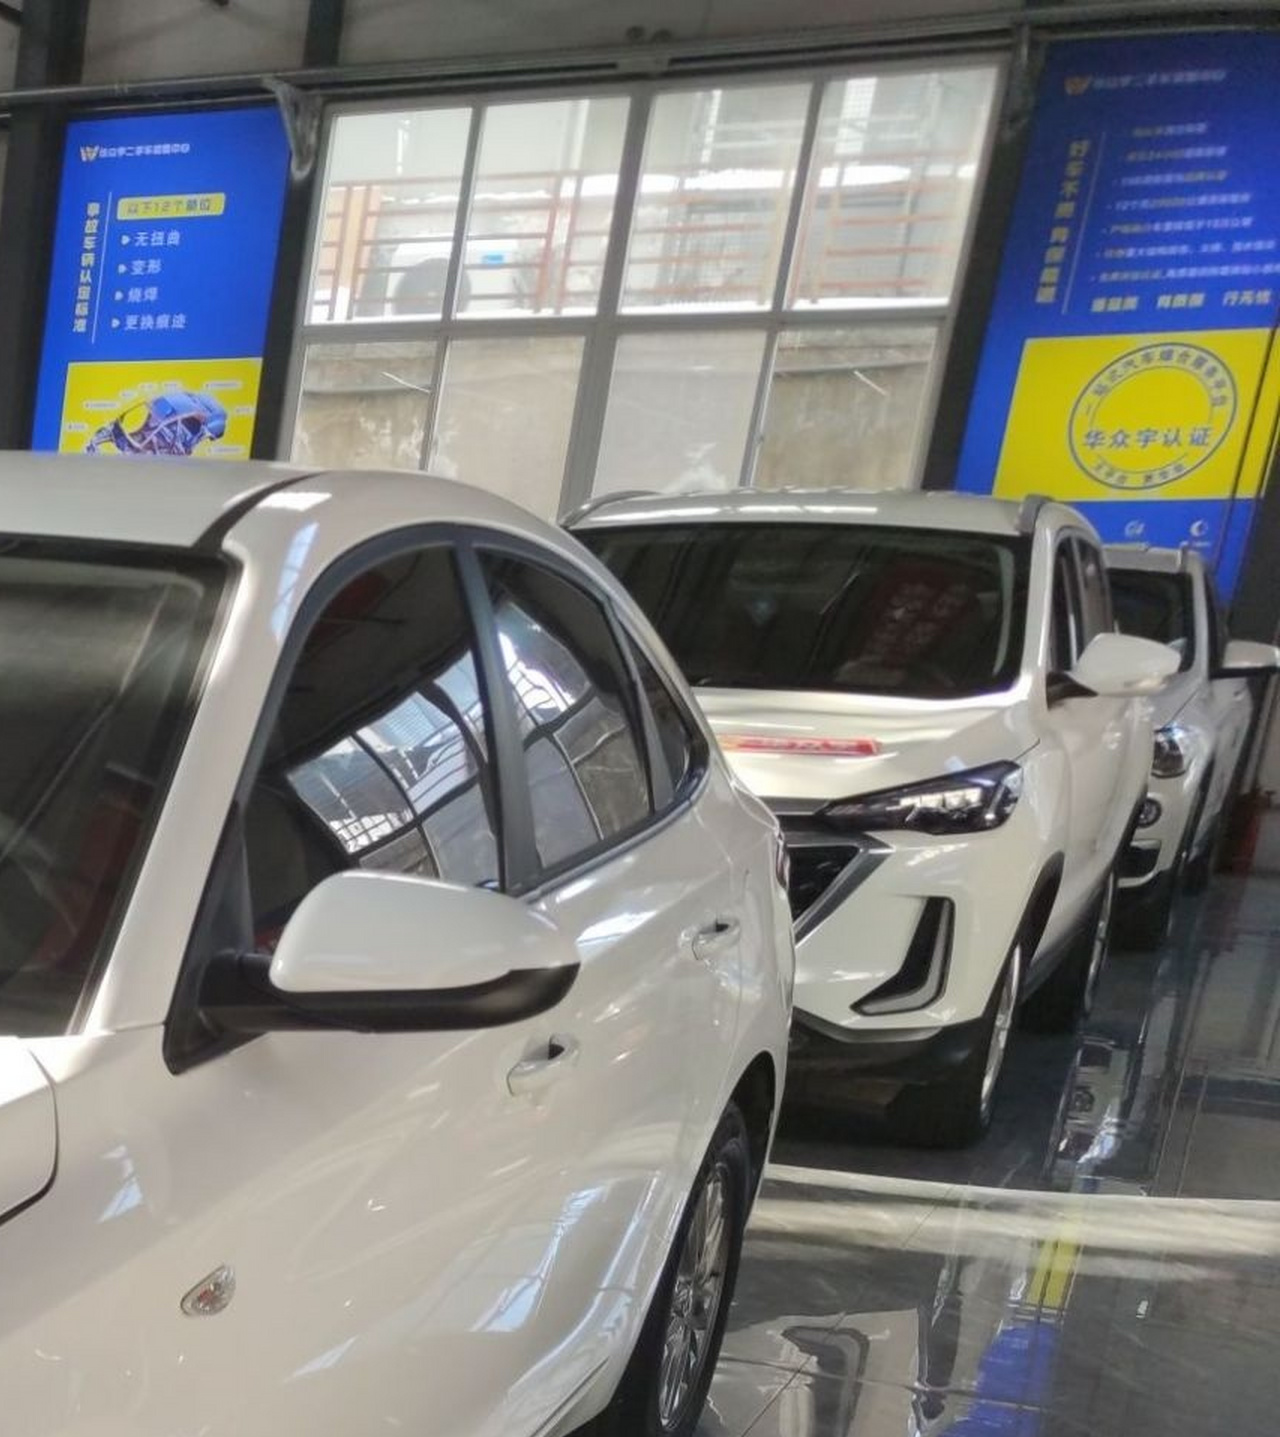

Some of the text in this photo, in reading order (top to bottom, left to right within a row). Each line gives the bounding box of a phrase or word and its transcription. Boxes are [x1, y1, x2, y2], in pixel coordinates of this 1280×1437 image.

[134, 230, 181, 247] 无扭曲
[131, 258, 162, 276] 变形
[1082, 426, 1213, 450] 华众宇认证
